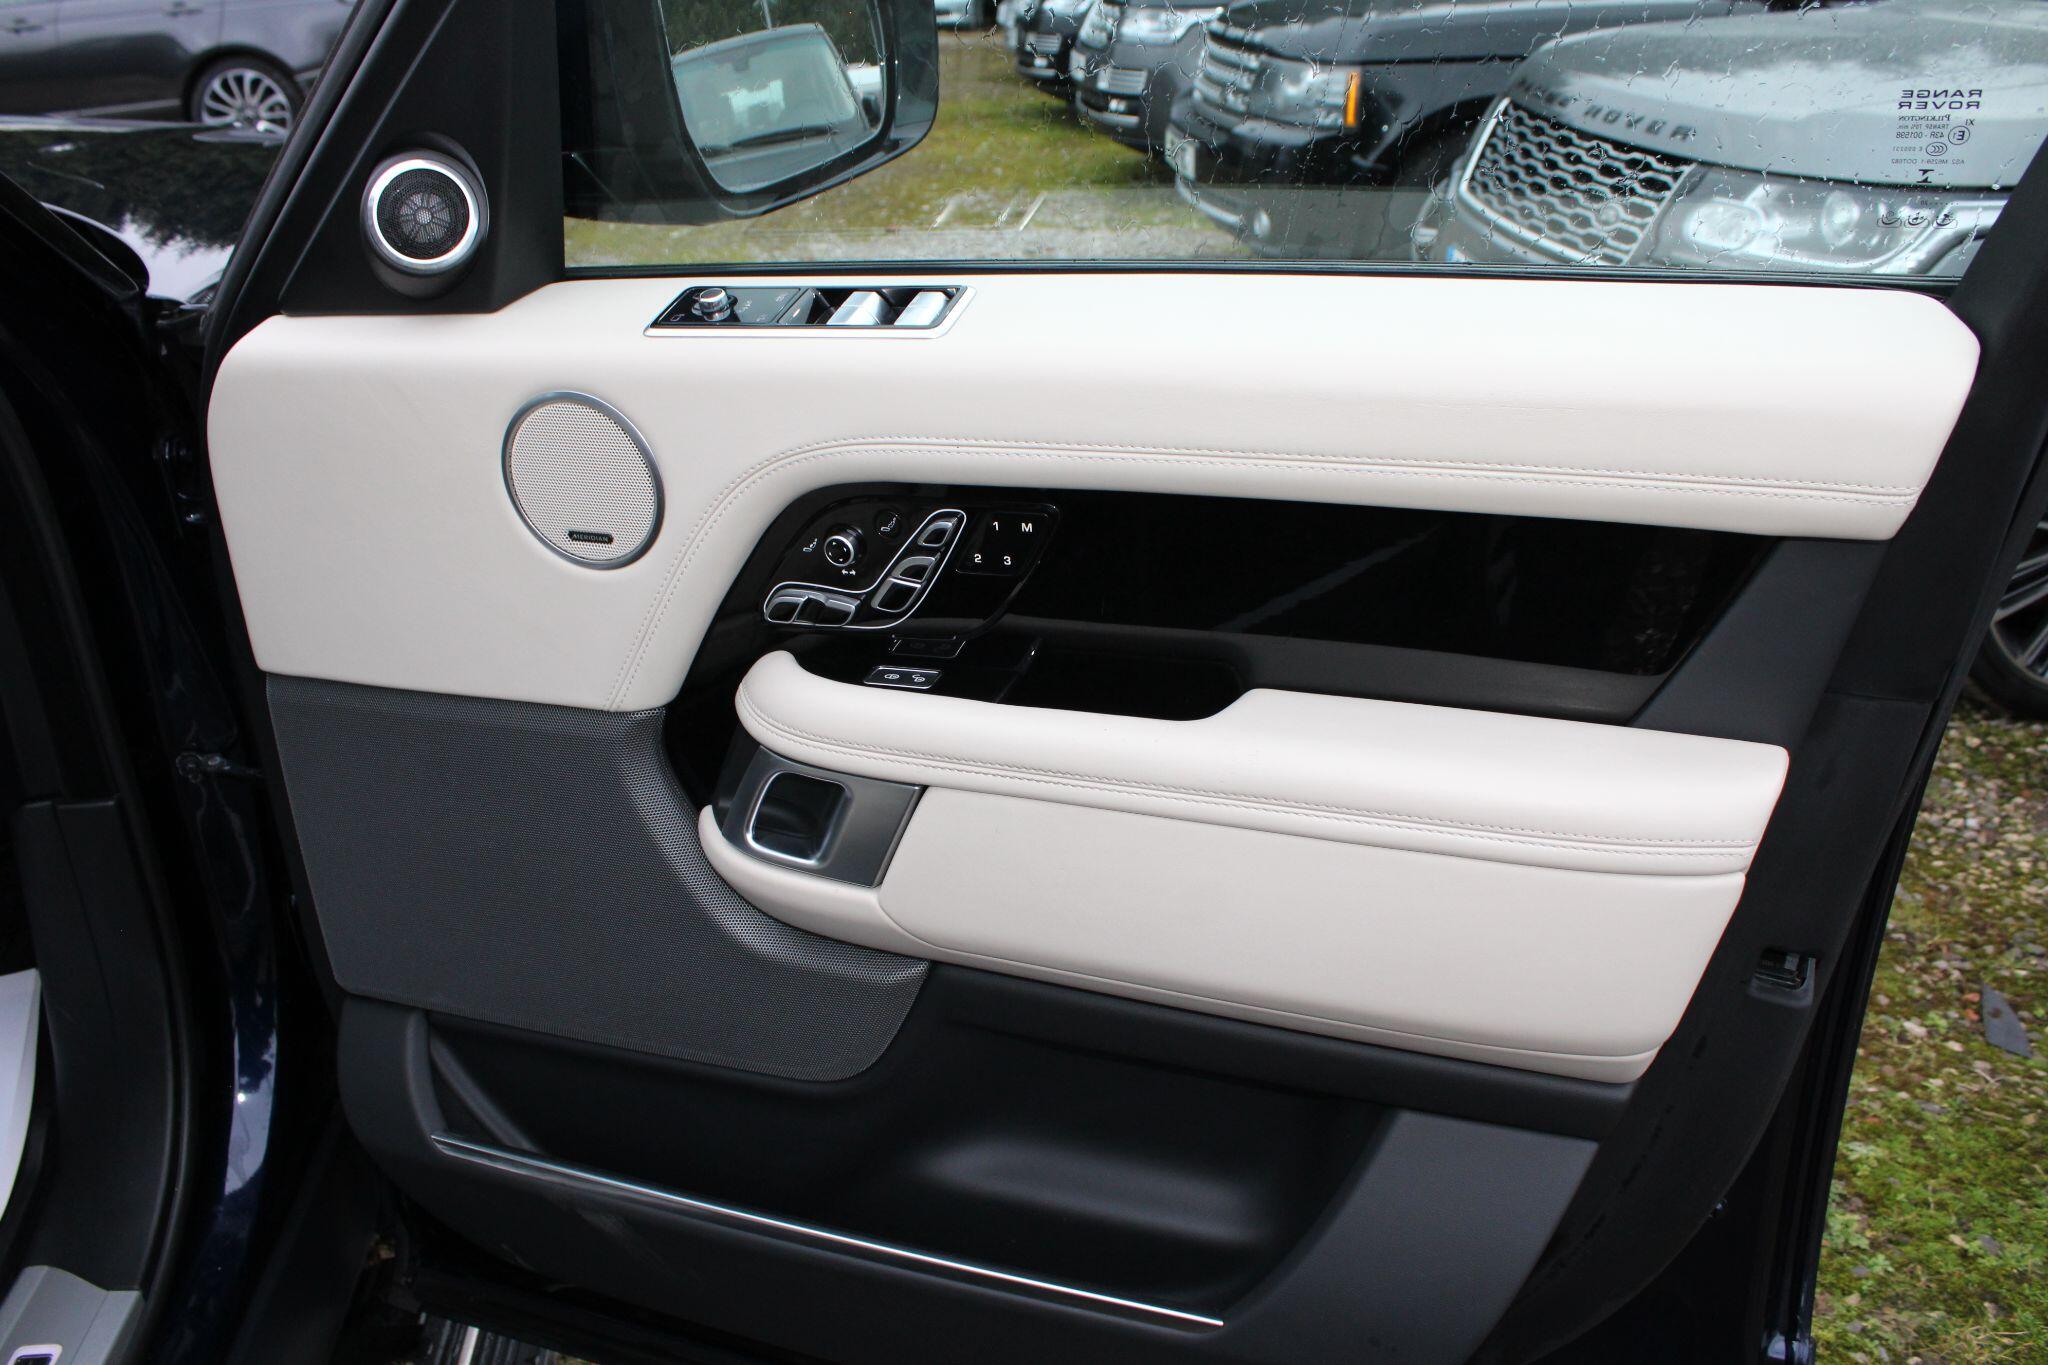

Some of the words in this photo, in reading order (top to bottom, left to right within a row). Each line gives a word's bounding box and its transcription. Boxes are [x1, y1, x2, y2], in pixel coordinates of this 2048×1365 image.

[993, 521, 999, 531] 1
[1021, 522, 1032, 533] M
[572, 534, 609, 542] MERIDIAN
[974, 553, 982, 563] 2
[1003, 555, 1011, 566] 3
